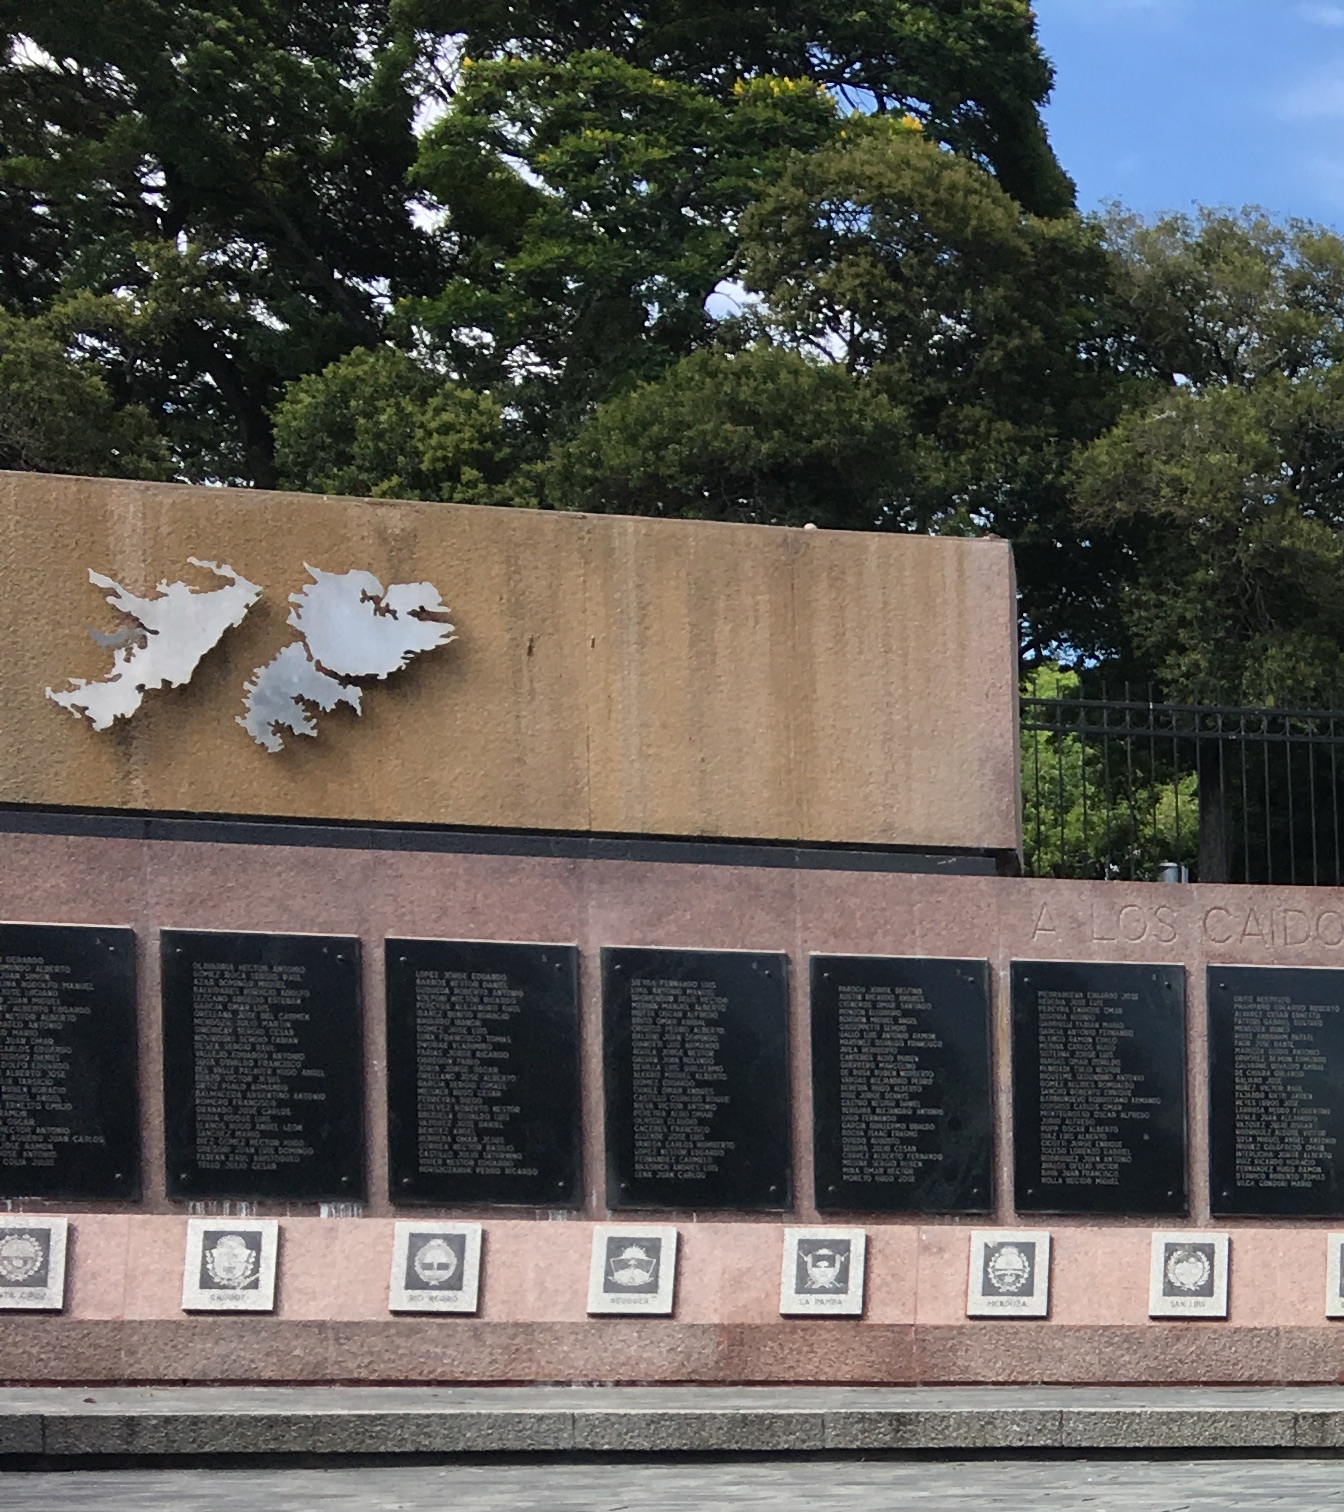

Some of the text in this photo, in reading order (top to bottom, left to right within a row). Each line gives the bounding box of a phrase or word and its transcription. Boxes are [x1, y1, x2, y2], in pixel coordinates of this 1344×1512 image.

[1031, 903, 1057, 942] A
[1091, 903, 1178, 943] LOS
[814, 1298, 843, 1306] PAMPA
